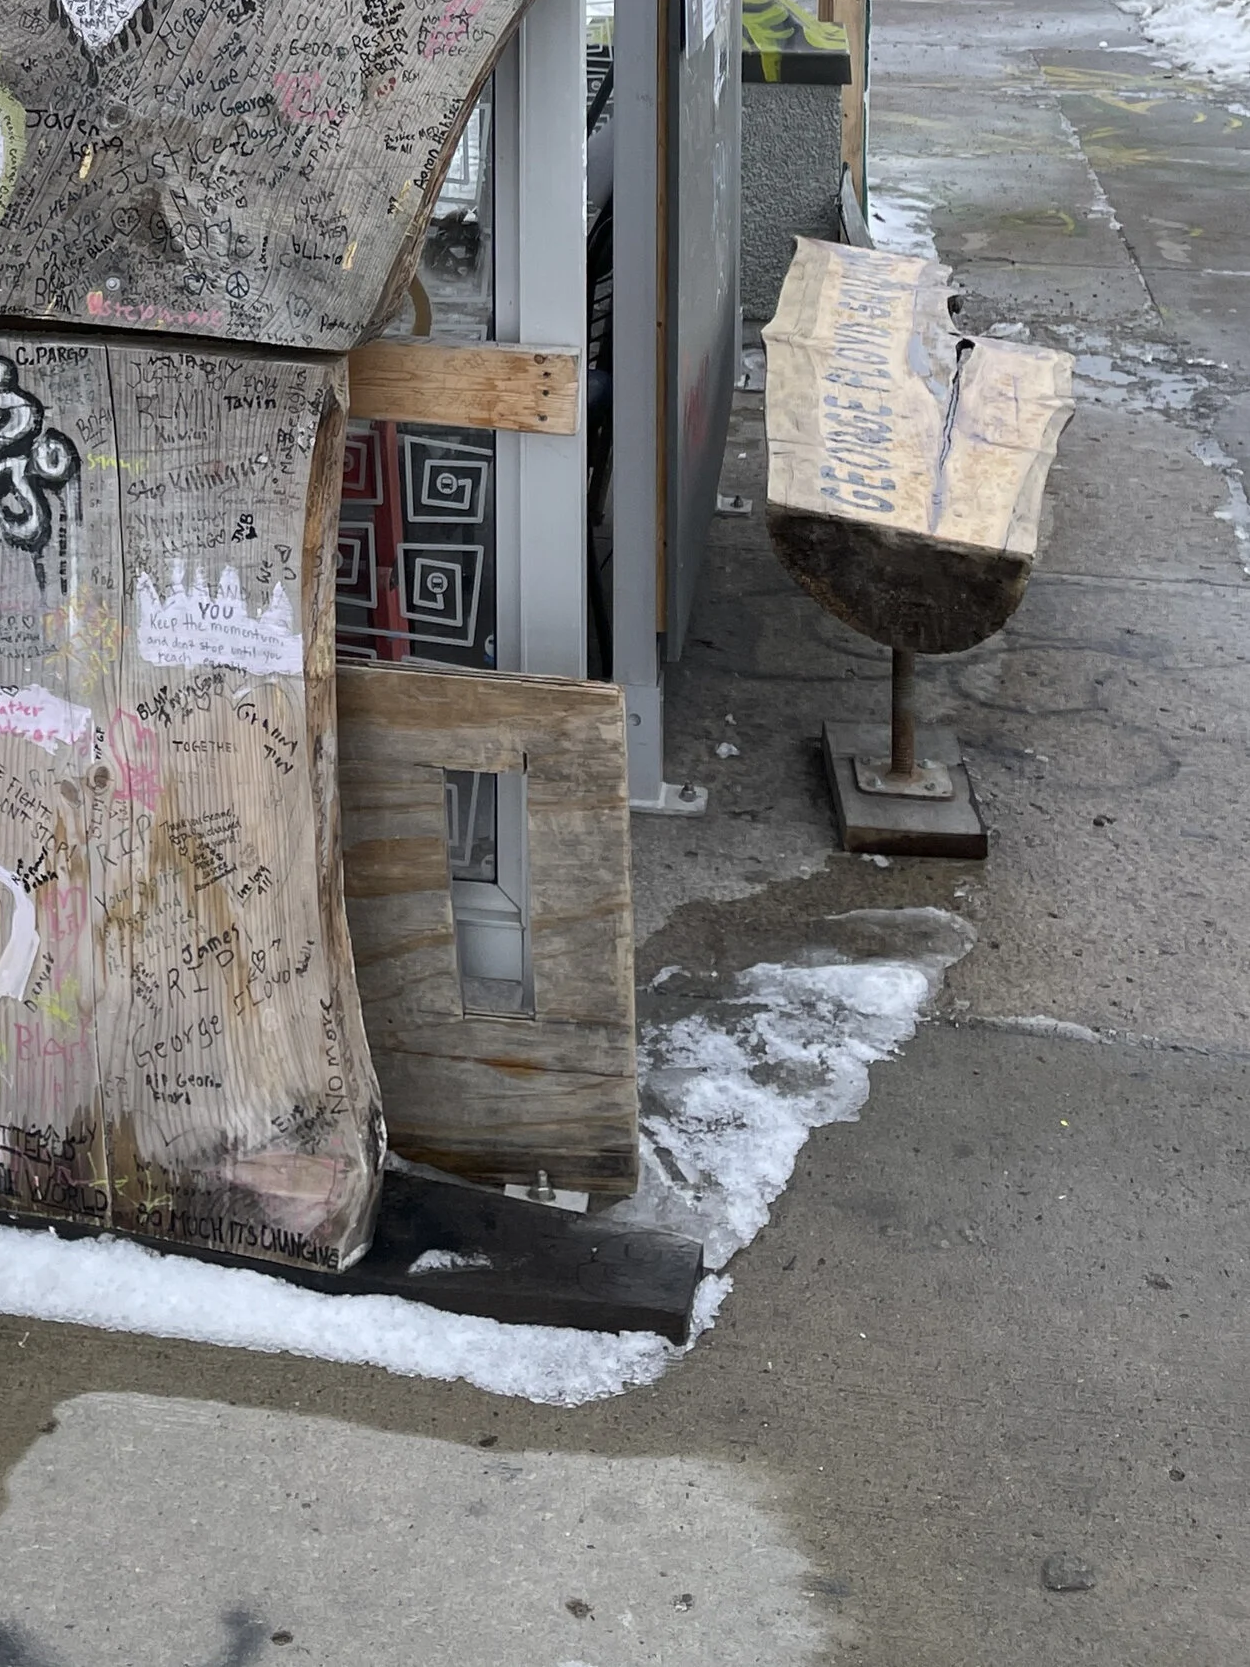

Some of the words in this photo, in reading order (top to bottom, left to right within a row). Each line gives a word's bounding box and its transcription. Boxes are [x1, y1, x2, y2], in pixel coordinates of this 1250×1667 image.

[220, 91, 276, 118] George
[86, 236, 114, 258] BLM
[224, 395, 277, 412] Tavin
[199, 602, 234, 620] YOU
[183, 614, 208, 630] the
[147, 637, 168, 648] and
[200, 641, 224, 655] stop
[157, 651, 192, 663] reach
[181, 923, 241, 966] James
[132, 1014, 224, 1070] George
[30, 1180, 110, 1215] WORLD
